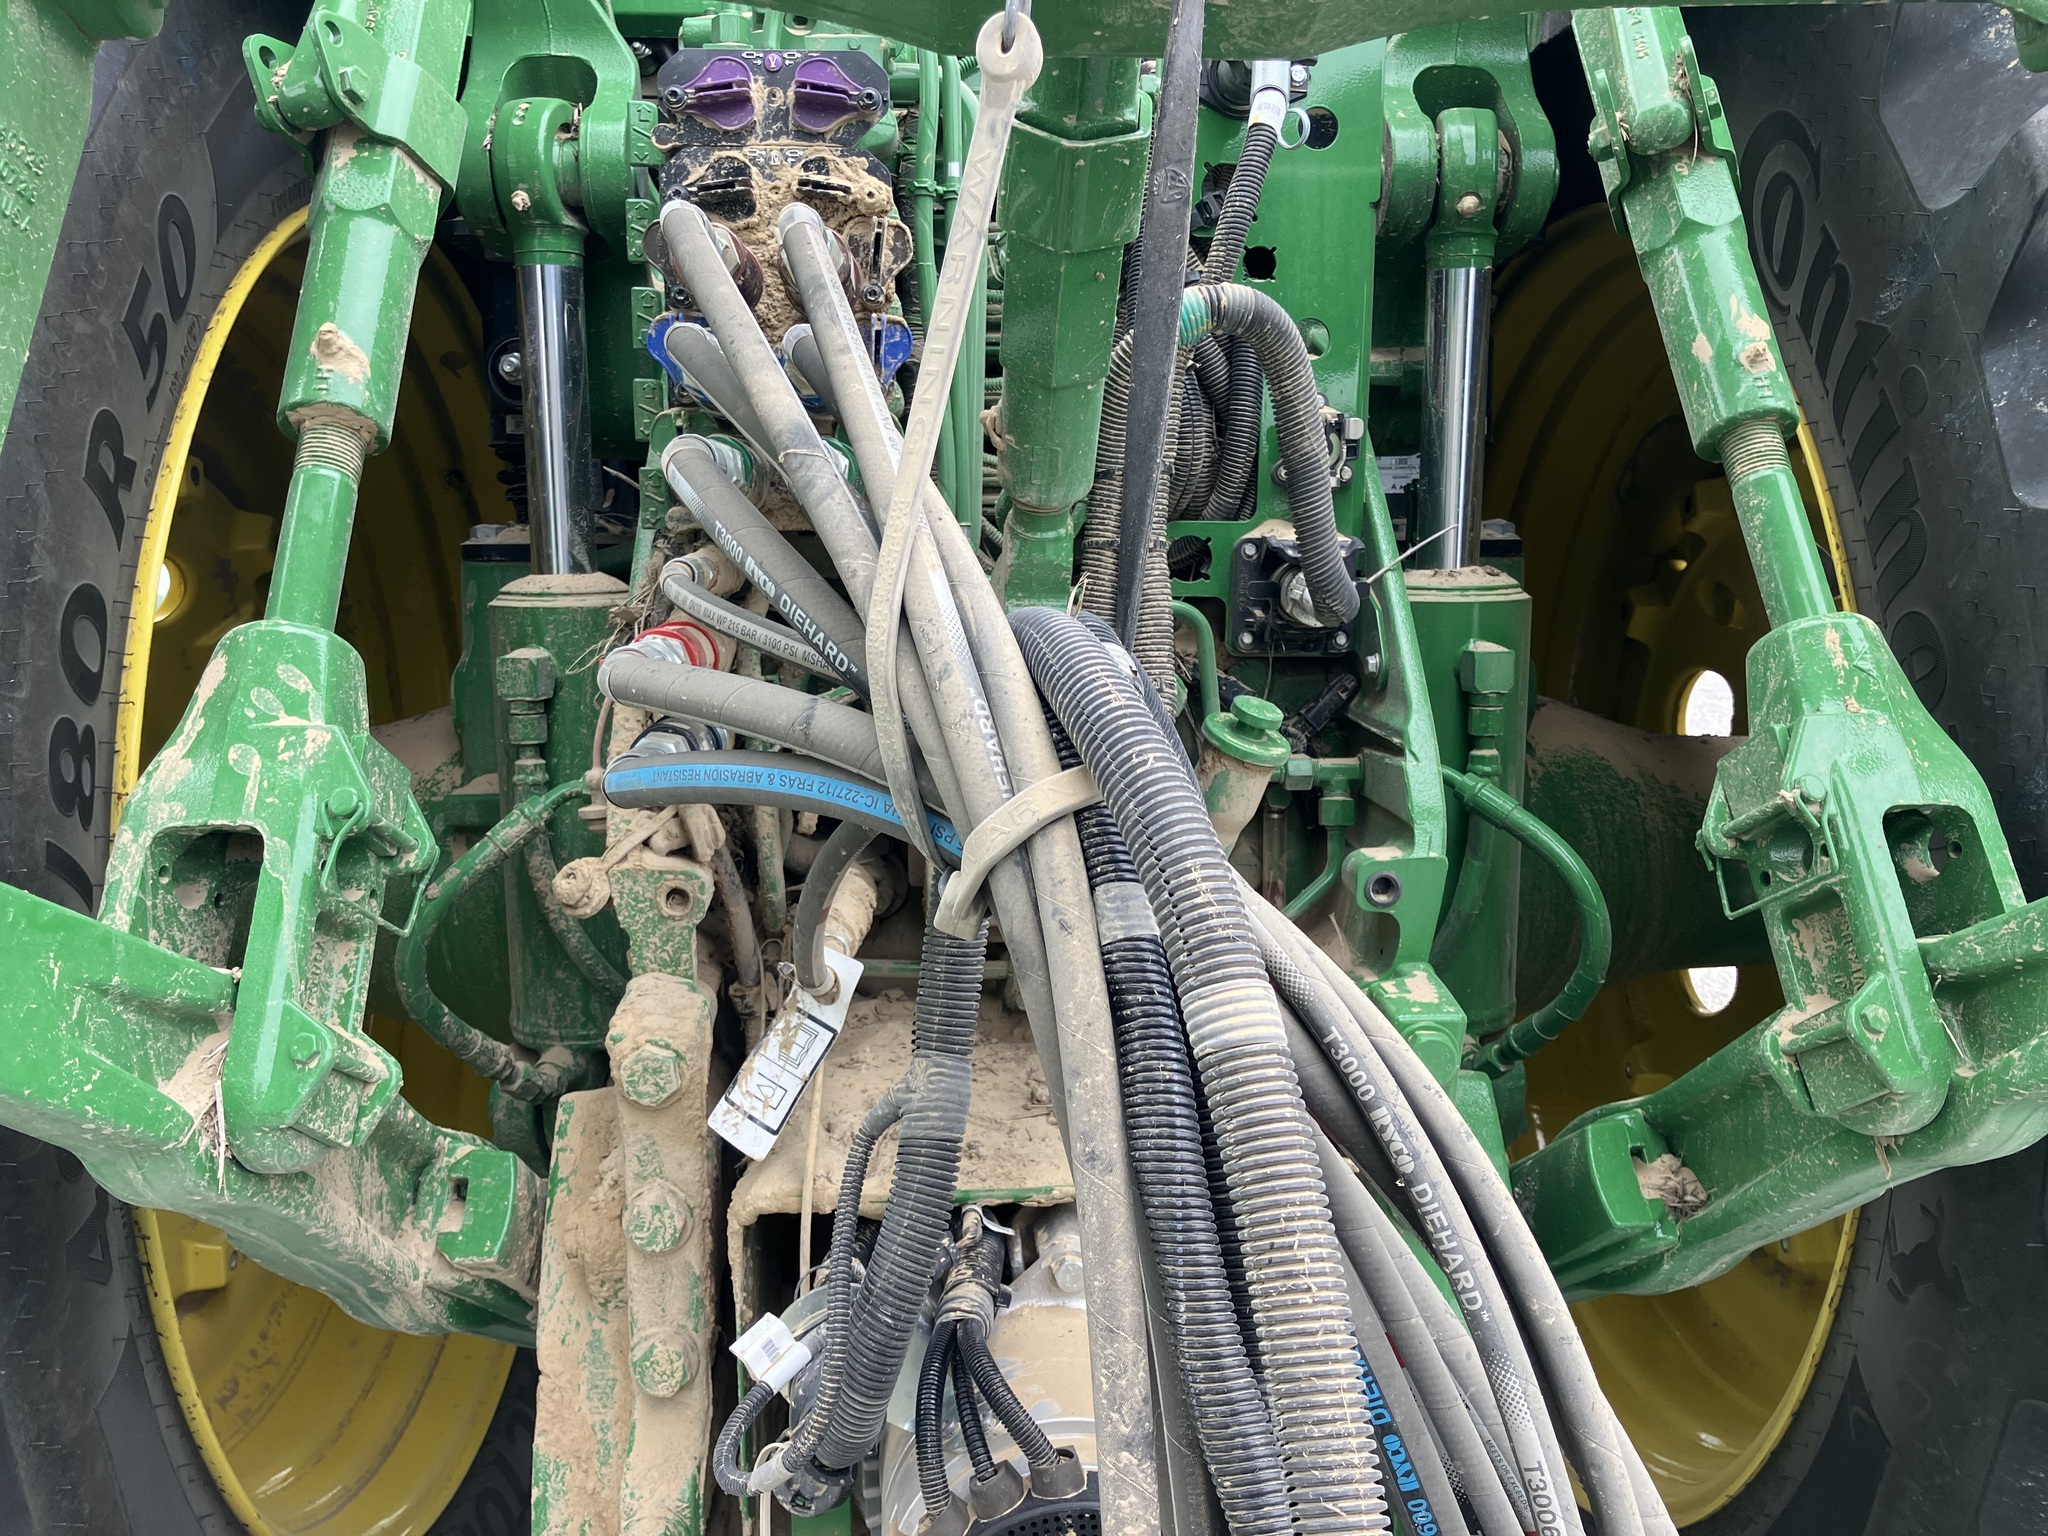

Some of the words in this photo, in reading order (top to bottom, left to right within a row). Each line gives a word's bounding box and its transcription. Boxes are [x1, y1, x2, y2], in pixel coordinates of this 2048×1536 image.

[906, 150, 992, 457] WARNING
[83, 407, 137, 551] R
[122, 193, 196, 413] 50
[714, 521, 743, 564] T3000
[702, 606, 717, 622] MAX
[717, 612, 728, 627] WP
[728, 618, 740, 634] 215
[741, 625, 757, 643] BAR
[763, 636, 781, 652] 3100
[783, 643, 799, 658] PSI
[652, 768, 701, 785] RESISTANT
[704, 767, 763, 783] ABRASION
[766, 773, 775, 785] &
[779, 773, 814, 791] FRAS
[817, 781, 877, 809] IC-227/12
[931, 822, 955, 843] PSI
[1323, 1026, 1375, 1102] T3000
[1369, 1105, 1415, 1176] RYCO
[1383, 1434, 1420, 1492] RYCO
[1486, 1439, 1504, 1465] MEETS
[1500, 1464, 1511, 1478] OR
[1507, 1476, 1527, 1510] EXCEEDS
